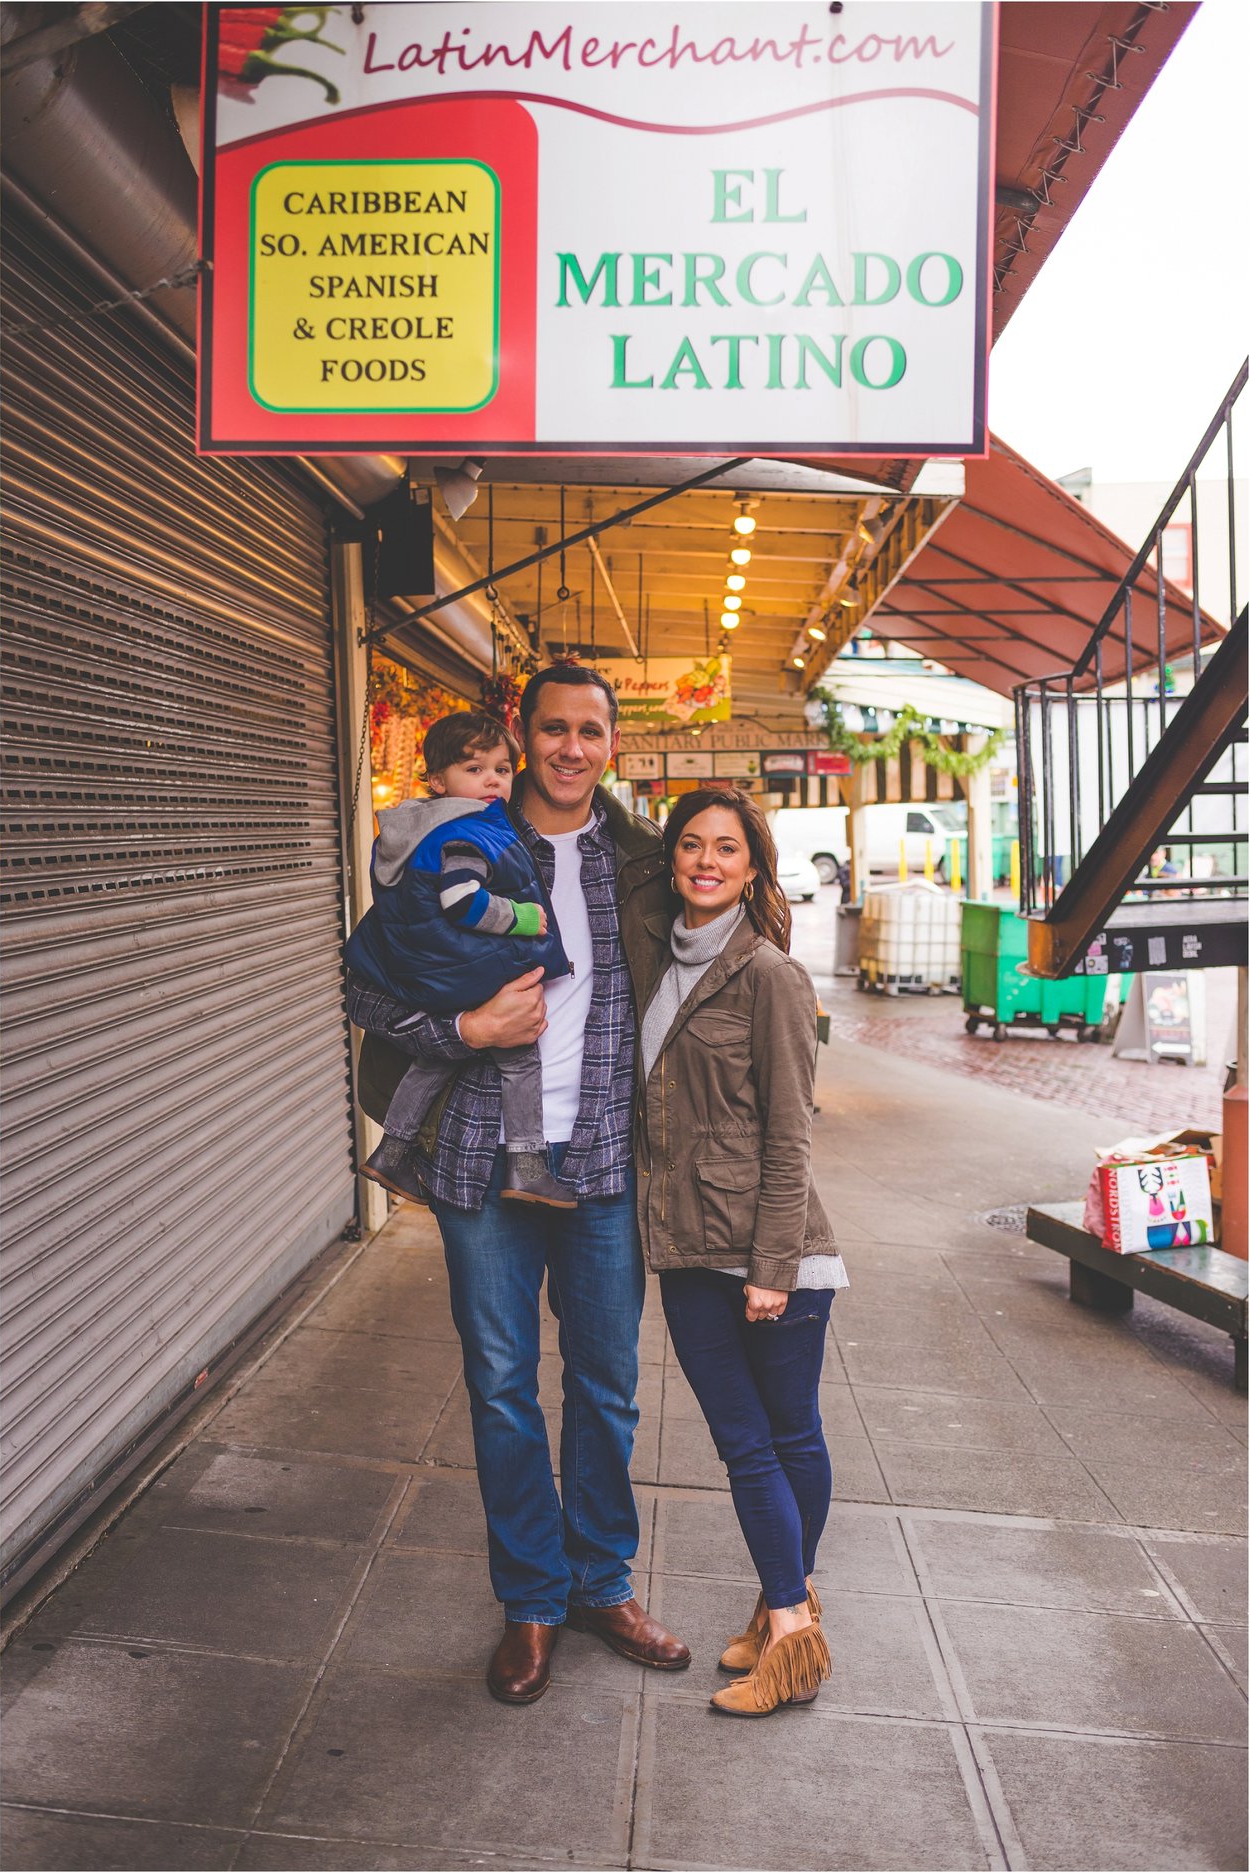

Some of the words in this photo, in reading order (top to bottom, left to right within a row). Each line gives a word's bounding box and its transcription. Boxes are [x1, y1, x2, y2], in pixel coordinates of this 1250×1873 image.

[363, 23, 955, 76] LatinMerchant.com
[283, 190, 468, 215] CARIBBEAN
[709, 168, 807, 224] EL
[260, 234, 307, 257] SO.
[318, 232, 490, 256] AMERICAN
[309, 274, 439, 299] SPANISH
[554, 250, 964, 308] MERCADO
[293, 317, 316, 340] &
[326, 316, 454, 340] CREOLE
[320, 359, 426, 382] FOODS
[608, 333, 907, 390] LATINO
[624, 678, 670, 696] Peppers
[620, 734, 703, 750] SANITARY
[710, 733, 768, 749] PUBLIC
[777, 732, 829, 748] MARK
